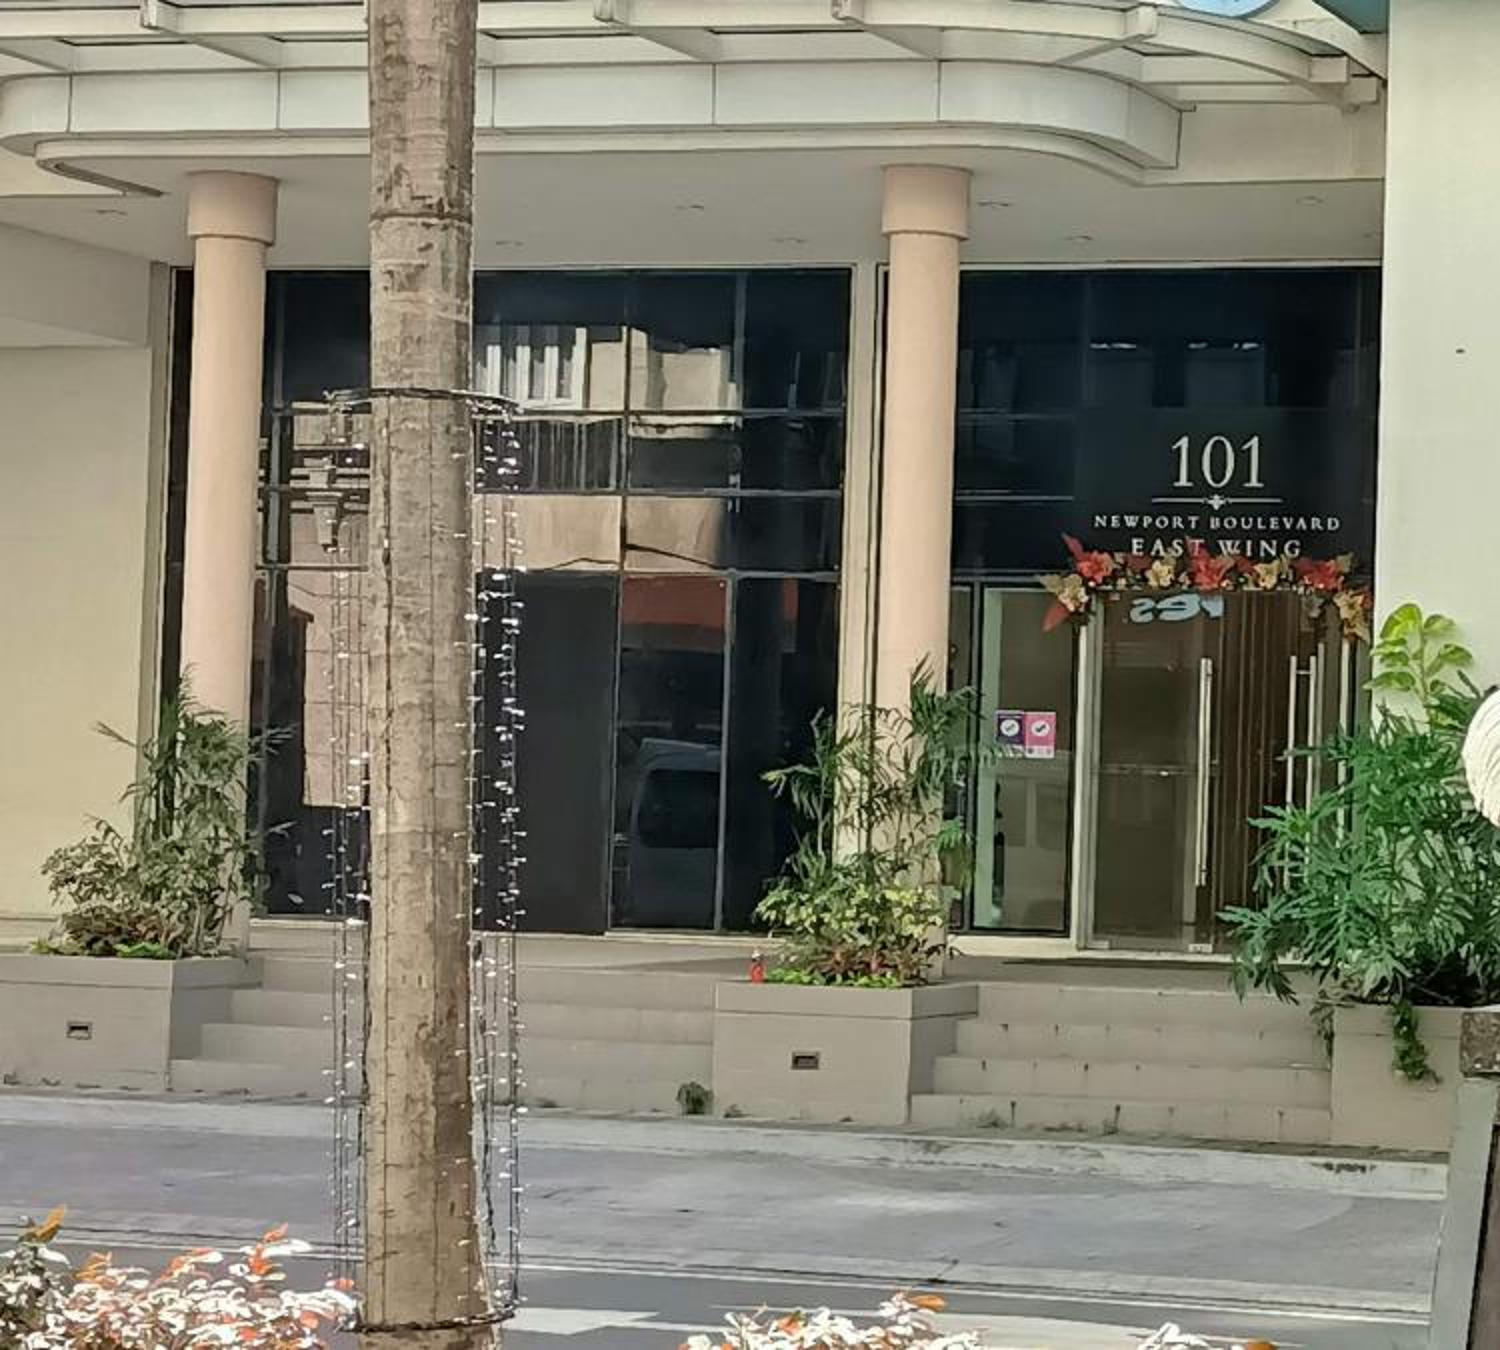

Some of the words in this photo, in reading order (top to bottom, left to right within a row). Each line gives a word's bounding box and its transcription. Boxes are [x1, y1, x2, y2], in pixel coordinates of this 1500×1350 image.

[1171, 435, 1265, 489] 101
[1094, 515, 1200, 530] NEWPORT
[1209, 516, 1341, 531] BOULEVARD
[1131, 538, 1204, 558] EAST
[1217, 539, 1302, 558] WING
